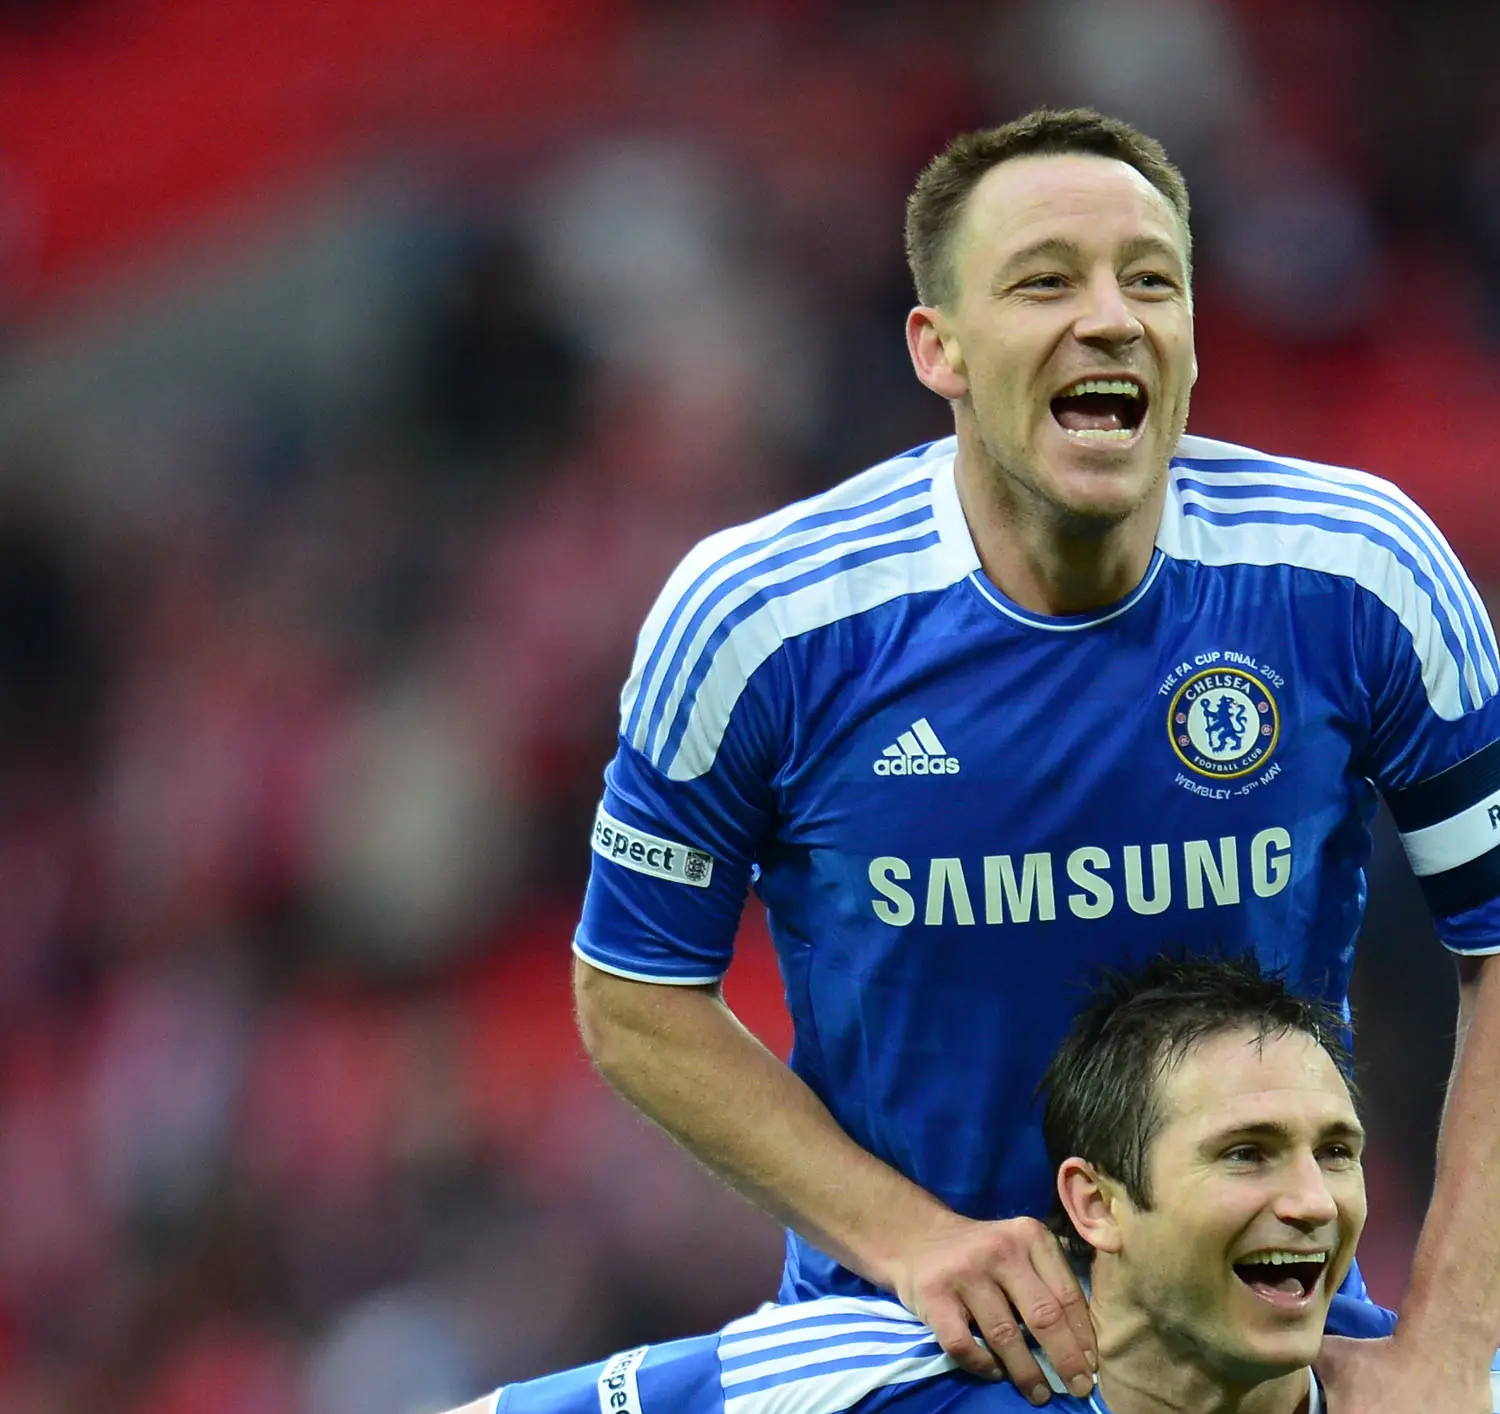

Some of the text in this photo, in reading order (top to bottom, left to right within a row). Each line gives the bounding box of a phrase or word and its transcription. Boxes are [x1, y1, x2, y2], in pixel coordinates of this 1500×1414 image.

[1158, 651, 1285, 697] THE FA CUP FINAL 2012
[1185, 675, 1251, 700] CHELSEA
[873, 755, 960, 776] adidas
[1194, 748, 1262, 772] FOOTBALL CLUB
[1174, 772, 1231, 800] WEMBLEY
[1259, 762, 1282, 785] MAY
[595, 820, 674, 871] espect
[868, 826, 1292, 927] SAMSUNG
